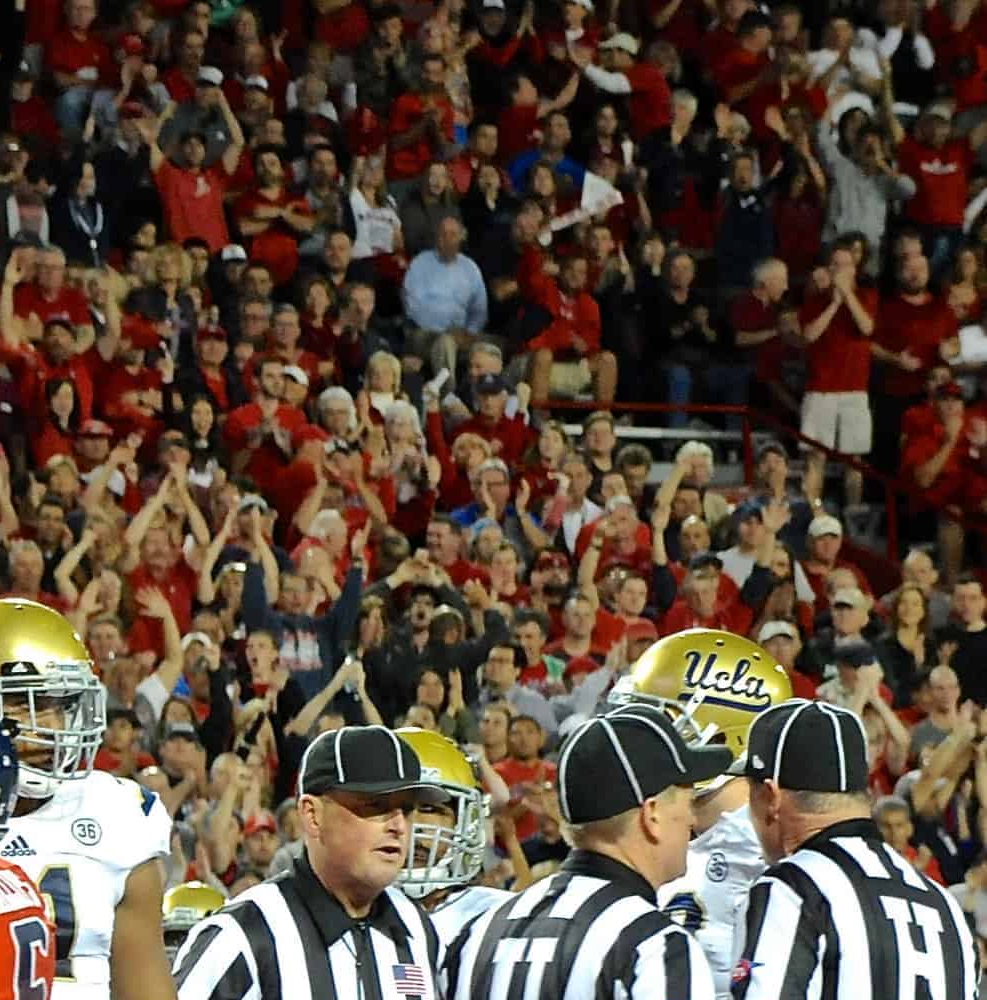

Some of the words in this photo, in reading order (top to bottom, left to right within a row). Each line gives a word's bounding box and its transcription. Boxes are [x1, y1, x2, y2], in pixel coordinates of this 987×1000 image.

[679, 651, 772, 713] Ucla
[76, 823, 97, 840] 36
[0, 849, 37, 857] adidas
